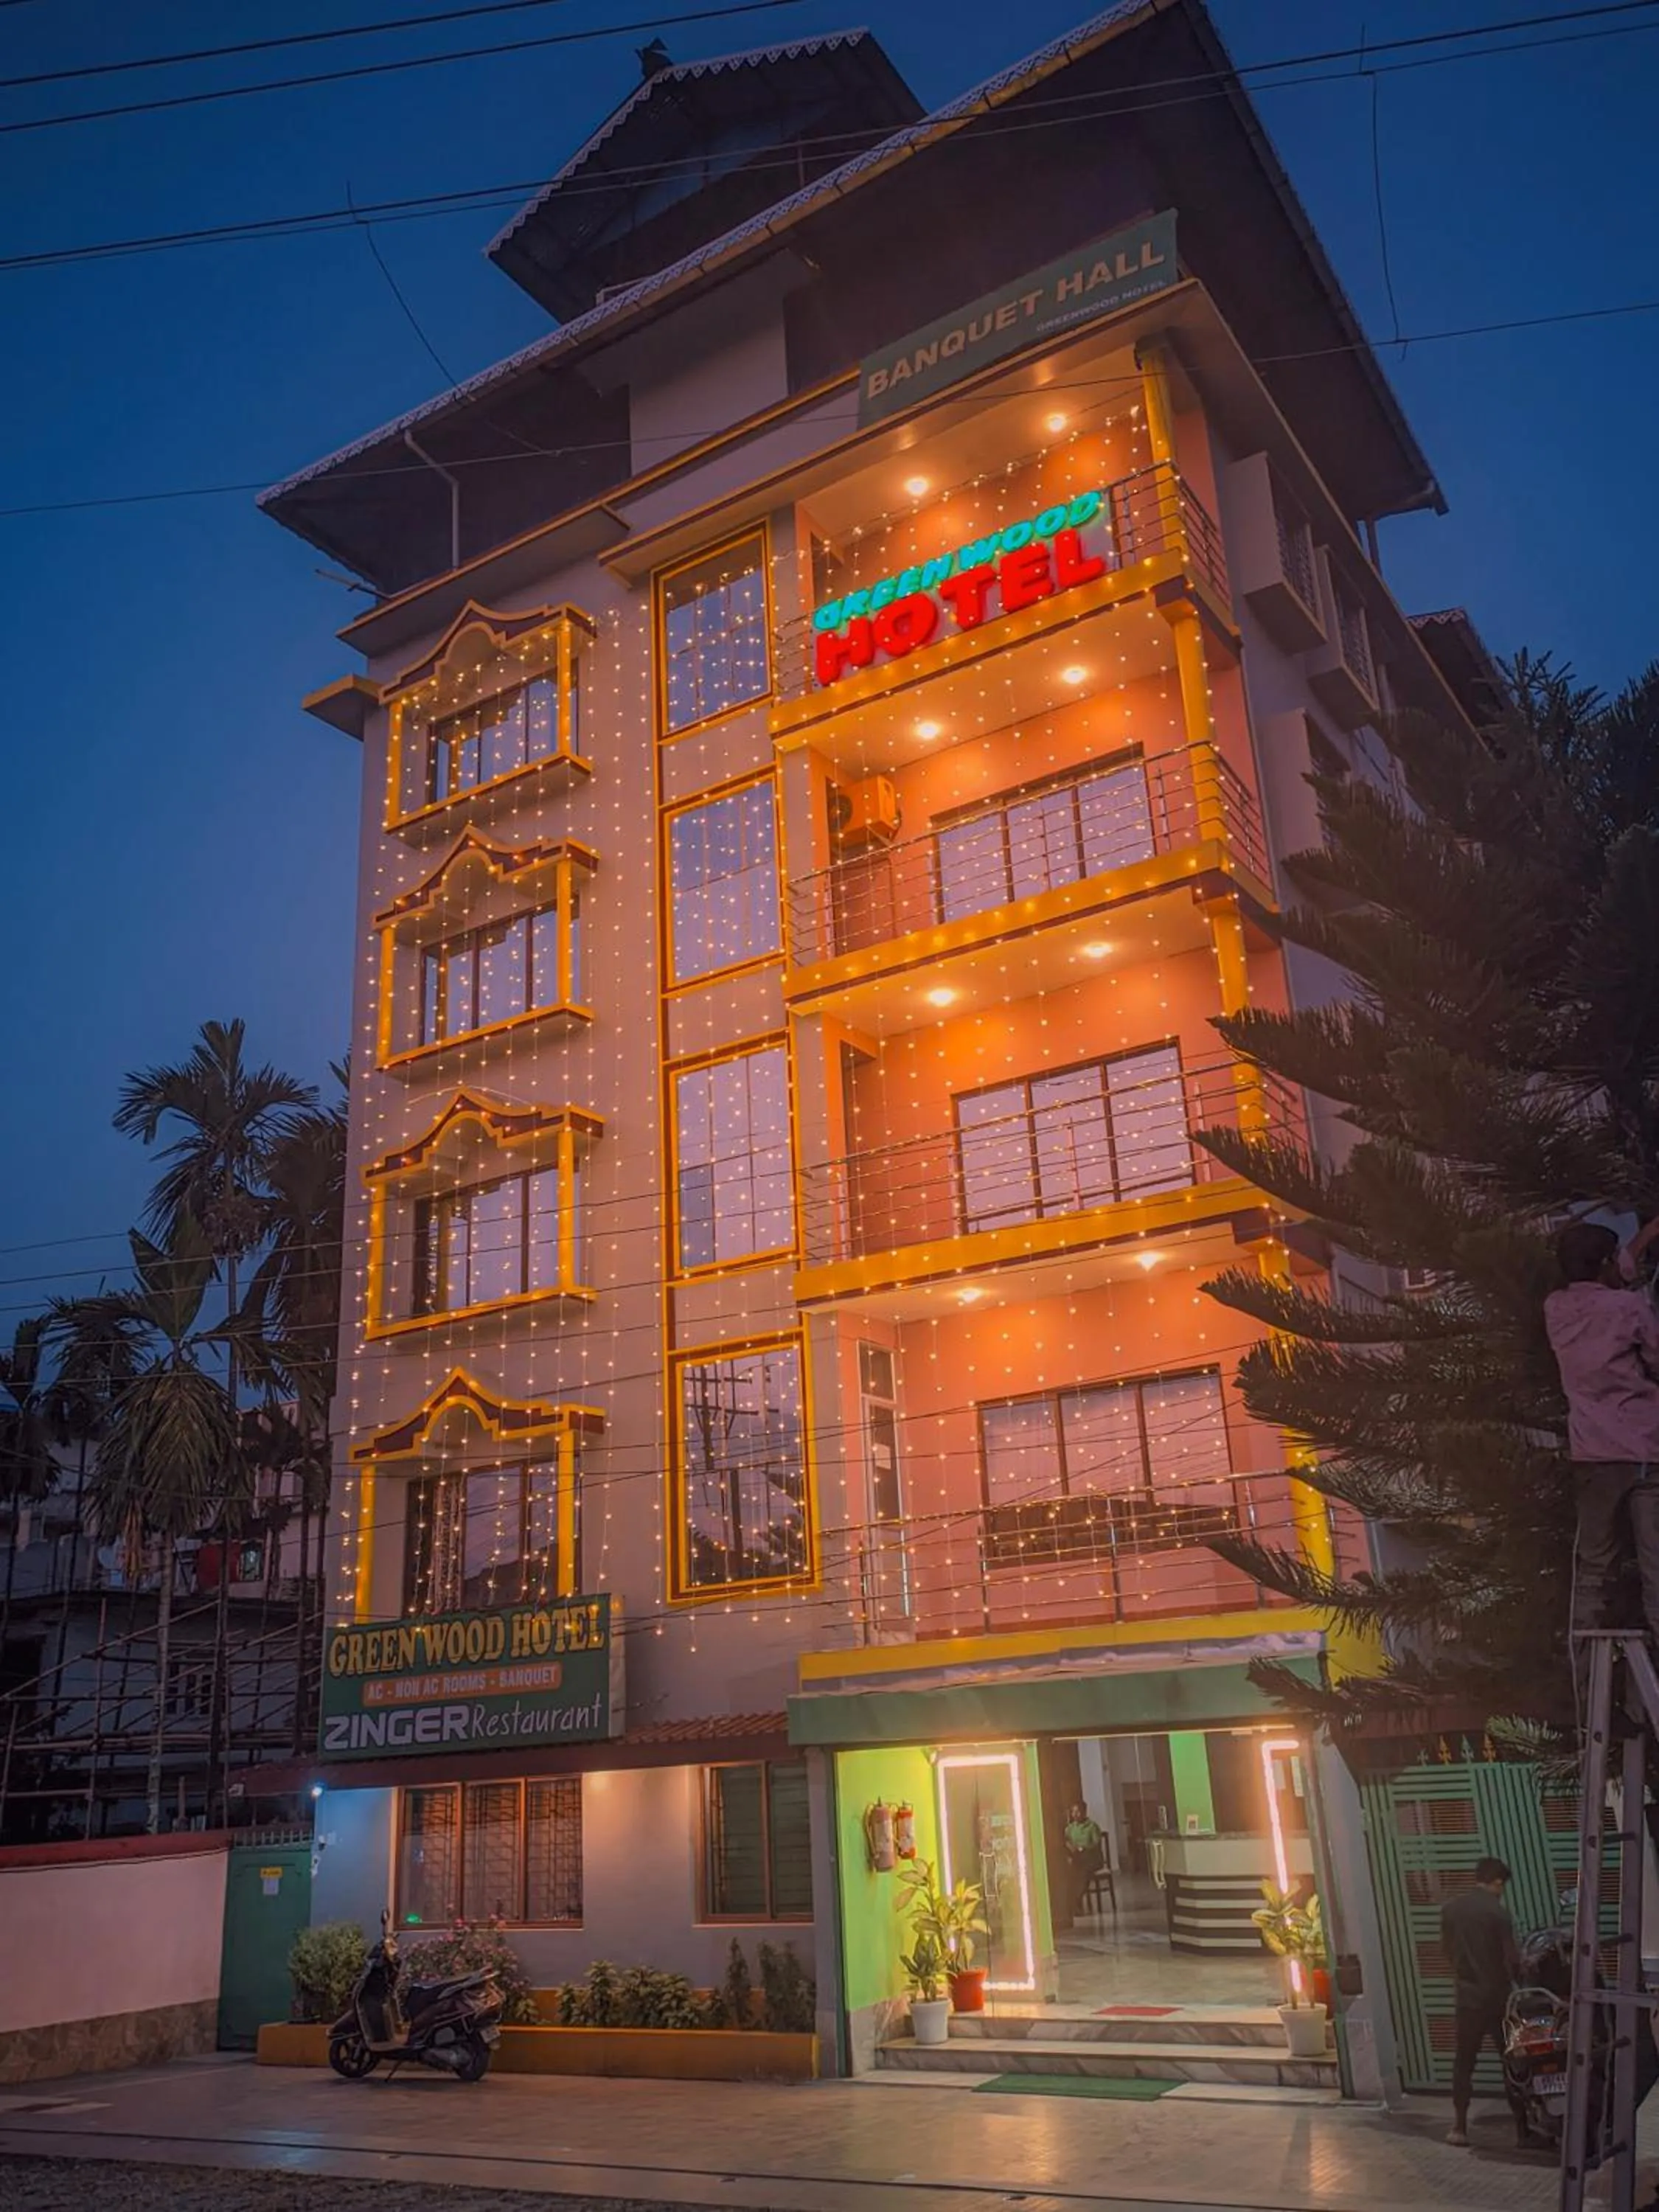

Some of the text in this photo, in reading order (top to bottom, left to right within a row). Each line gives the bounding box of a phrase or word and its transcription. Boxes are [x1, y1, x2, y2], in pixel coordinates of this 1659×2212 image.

[1121, 279, 1167, 299] HOTEL
[866, 241, 1165, 399] BANQUET HALL
[815, 528, 1105, 687] HOTEL
[510, 1603, 605, 1658] HOTEL
[369, 1683, 383, 1700] AC
[395, 1680, 420, 1699] NON
[422, 1678, 440, 1696] AC
[443, 1674, 487, 1694] ROOMS
[498, 1666, 557, 1688] BANQUET
[324, 1692, 603, 1751] ZINGER Restaurant
